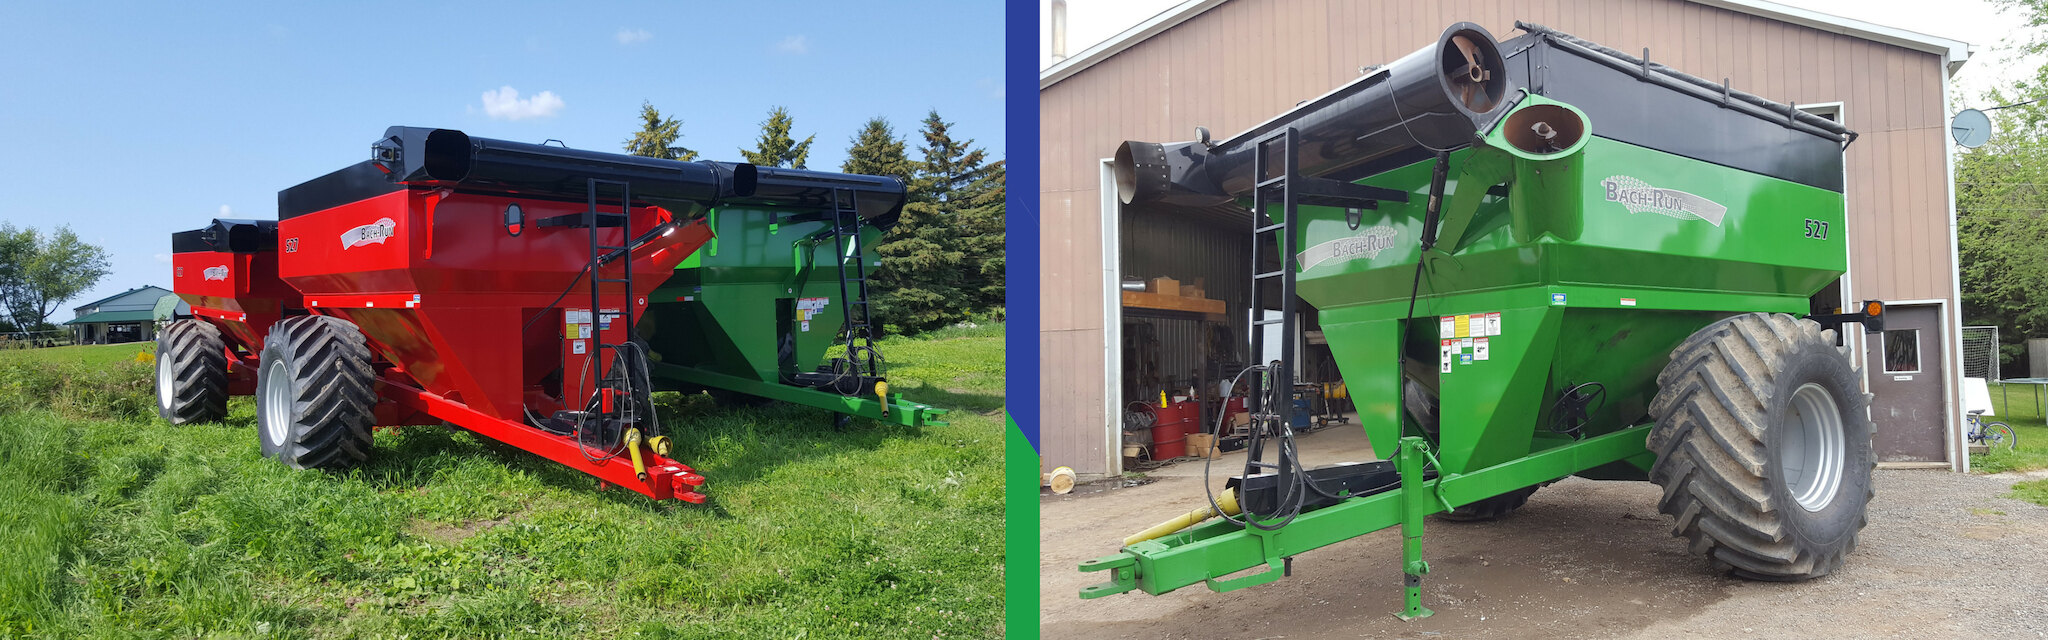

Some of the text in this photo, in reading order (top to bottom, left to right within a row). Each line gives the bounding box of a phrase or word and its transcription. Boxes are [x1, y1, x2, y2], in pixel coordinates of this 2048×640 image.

[1606, 181, 1682, 211] BACH-RUN
[1805, 219, 1829, 240] 527
[286, 238, 298, 253] 527
[1333, 234, 1395, 257] BACH-RUN
